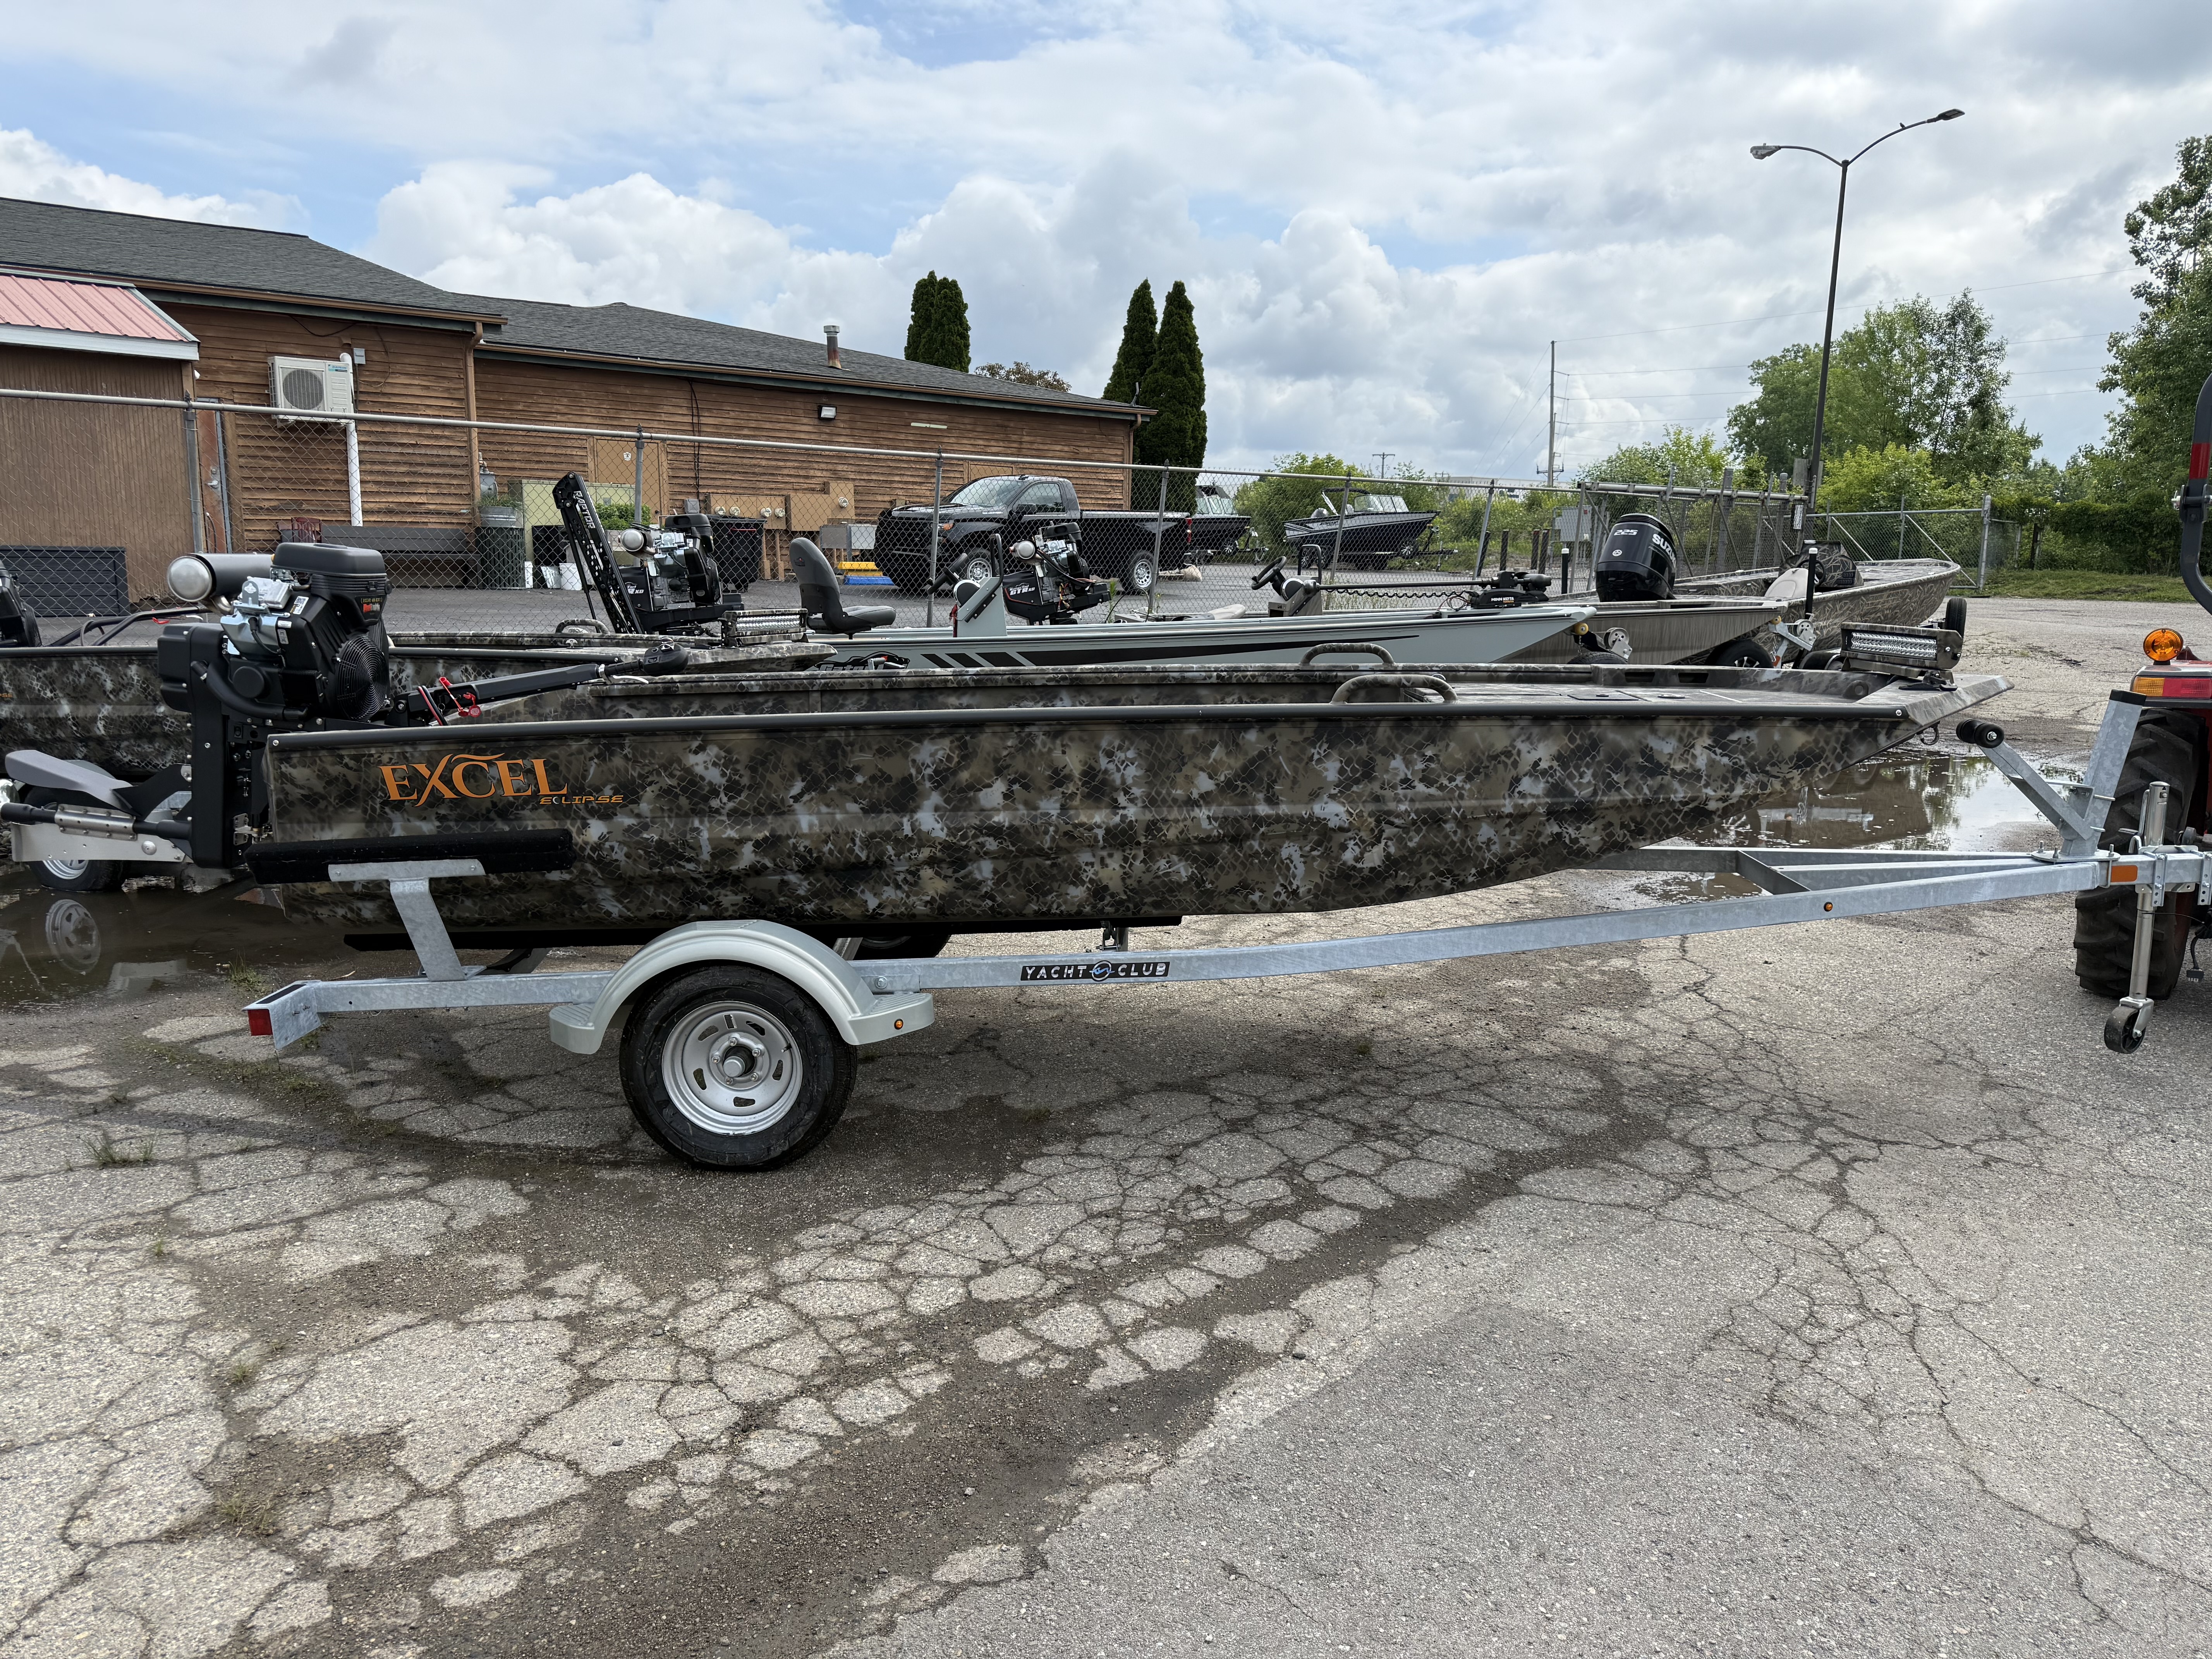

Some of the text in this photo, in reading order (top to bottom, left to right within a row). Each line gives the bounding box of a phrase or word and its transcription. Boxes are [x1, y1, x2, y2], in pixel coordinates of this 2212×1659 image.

[573, 491, 596, 529] RAPTOR
[1652, 533, 1676, 568] SUZUKI
[377, 753, 568, 807] EXCEL
[539, 795, 624, 804] ECLIPSE
[1025, 963, 1167, 981] YACHT CLUB
